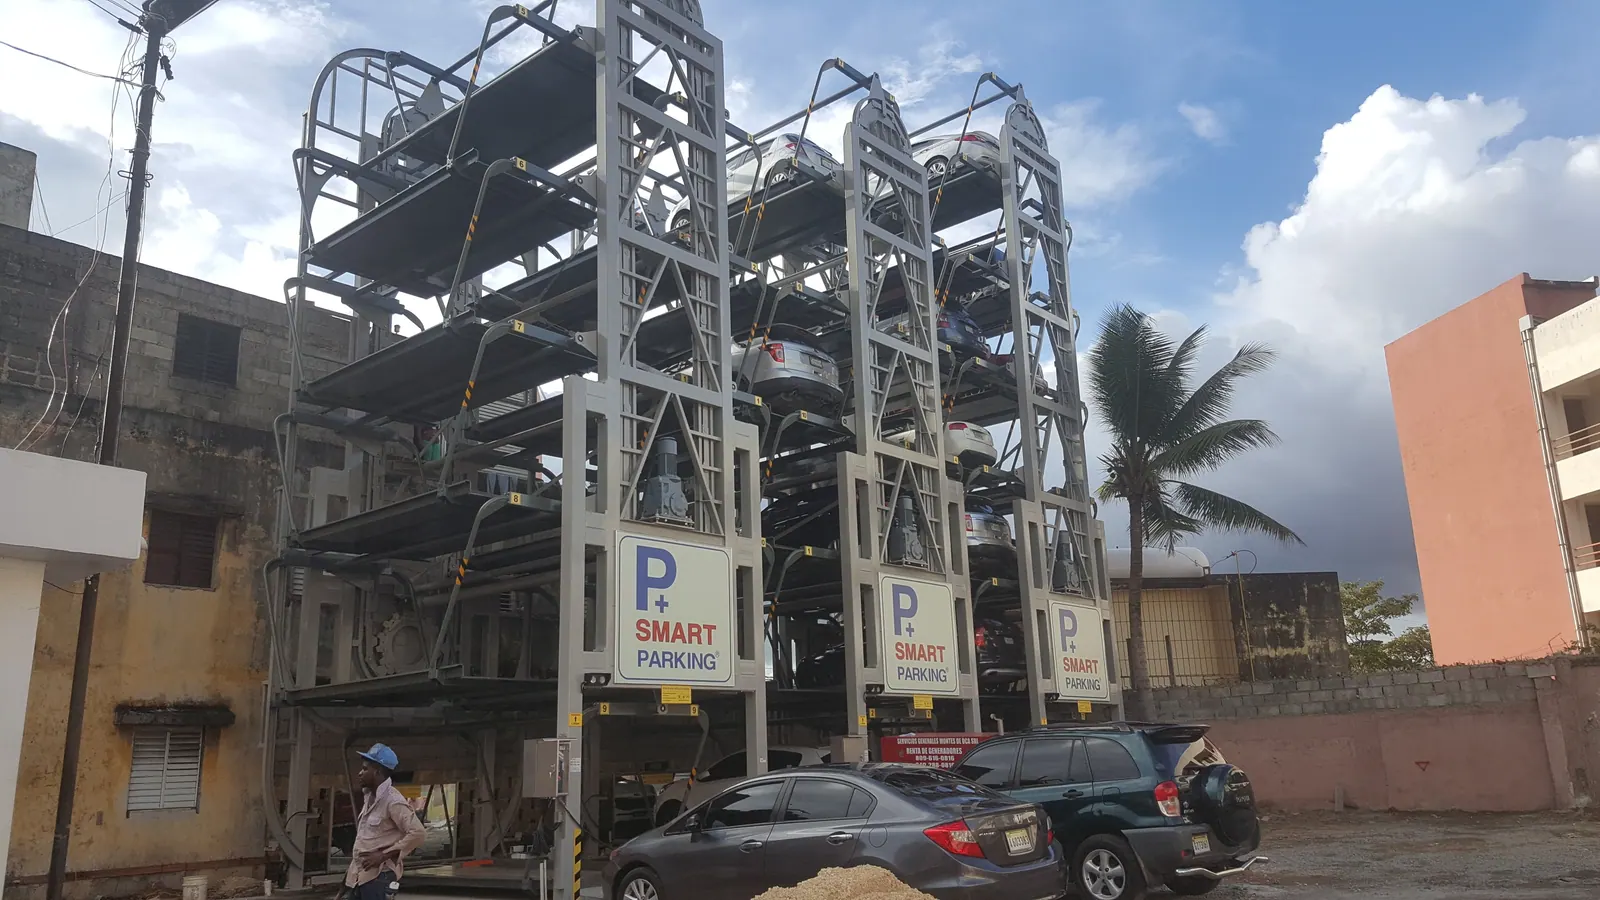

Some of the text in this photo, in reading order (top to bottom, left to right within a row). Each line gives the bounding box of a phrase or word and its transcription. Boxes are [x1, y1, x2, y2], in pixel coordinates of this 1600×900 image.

[636, 618, 717, 646] SMART
[895, 642, 946, 662] SMART
[1062, 656, 1098, 674] SMART
